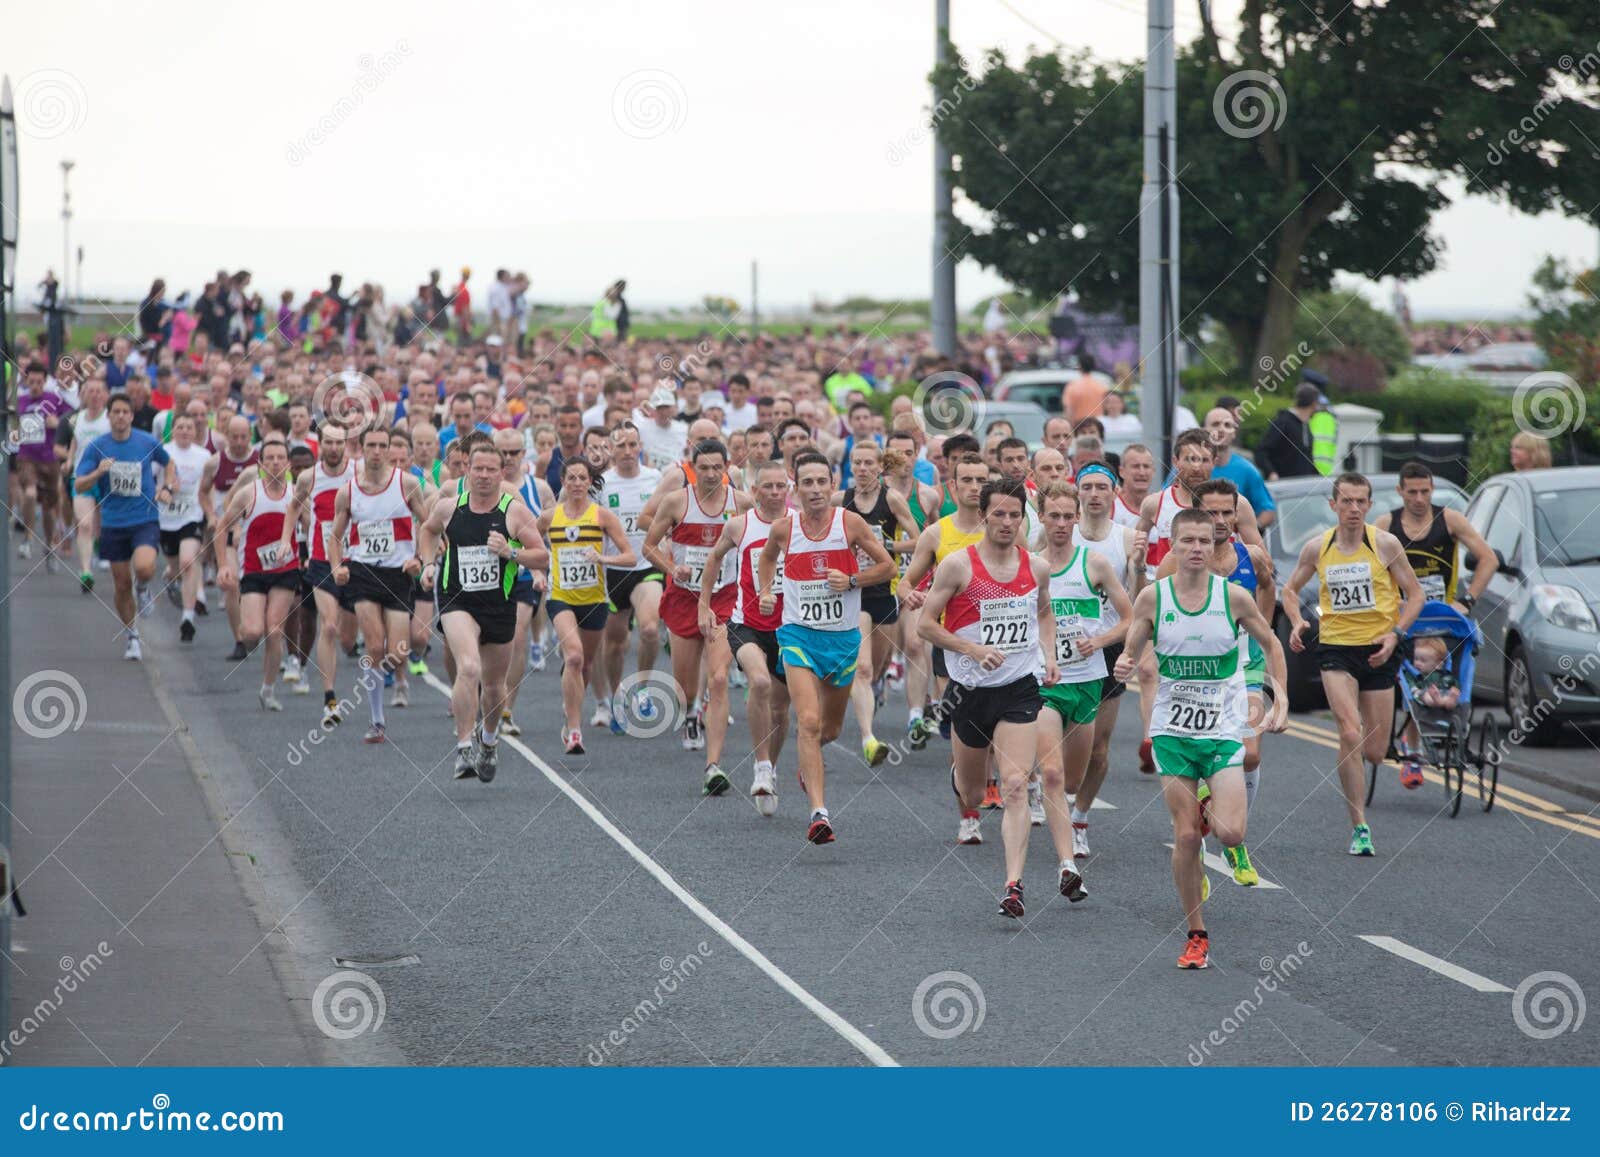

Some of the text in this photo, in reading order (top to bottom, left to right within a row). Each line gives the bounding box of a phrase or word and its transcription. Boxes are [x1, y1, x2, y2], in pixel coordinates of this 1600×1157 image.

[365, 538, 389, 553] 262
[462, 565, 498, 583] 1365
[562, 564, 596, 582] 1324
[1331, 584, 1371, 605] 2341
[801, 600, 843, 621] 2010
[983, 621, 1028, 646] 2222
[1168, 659, 1221, 676] RAHENY
[1169, 704, 1221, 731] 2207
